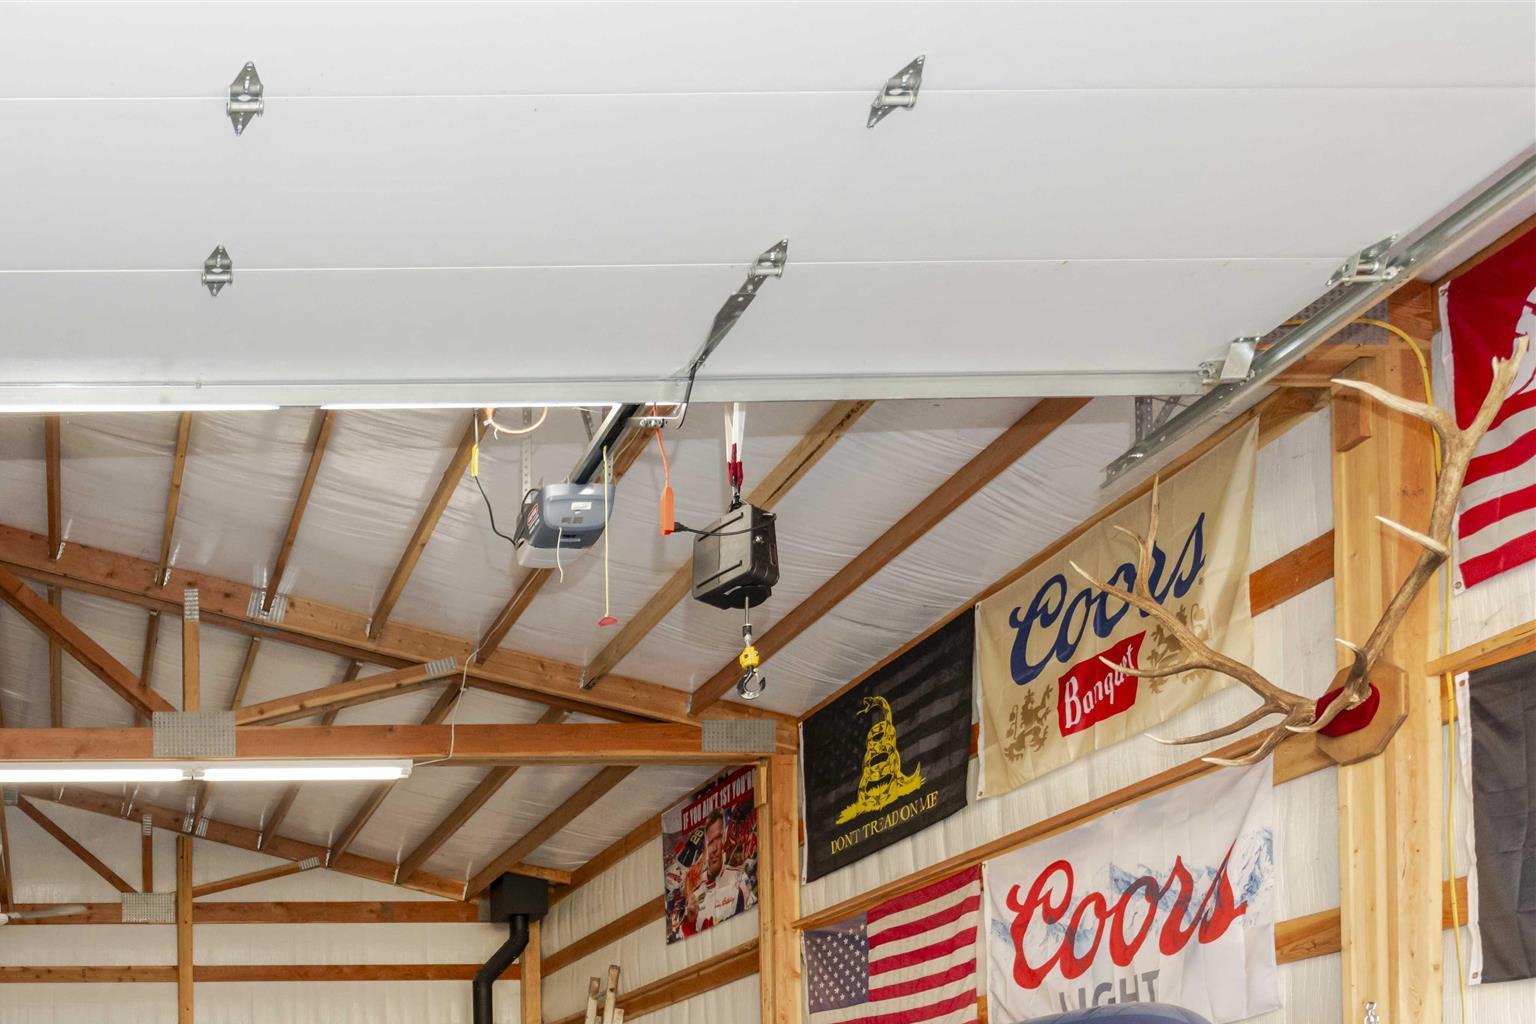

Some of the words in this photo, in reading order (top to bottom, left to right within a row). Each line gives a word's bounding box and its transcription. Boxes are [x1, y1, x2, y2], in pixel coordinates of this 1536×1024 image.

[1009, 512, 1206, 685] Coors
[1064, 644, 1134, 729] Banquet
[683, 811, 689, 831] IF
[690, 803, 701, 826] YOU
[703, 792, 718, 819] AIN'T
[720, 784, 731, 807] 1ST
[862, 811, 900, 839] TREAD
[900, 803, 919, 822] ON
[919, 791, 939, 811] ME
[1006, 838, 1247, 989] Coors
